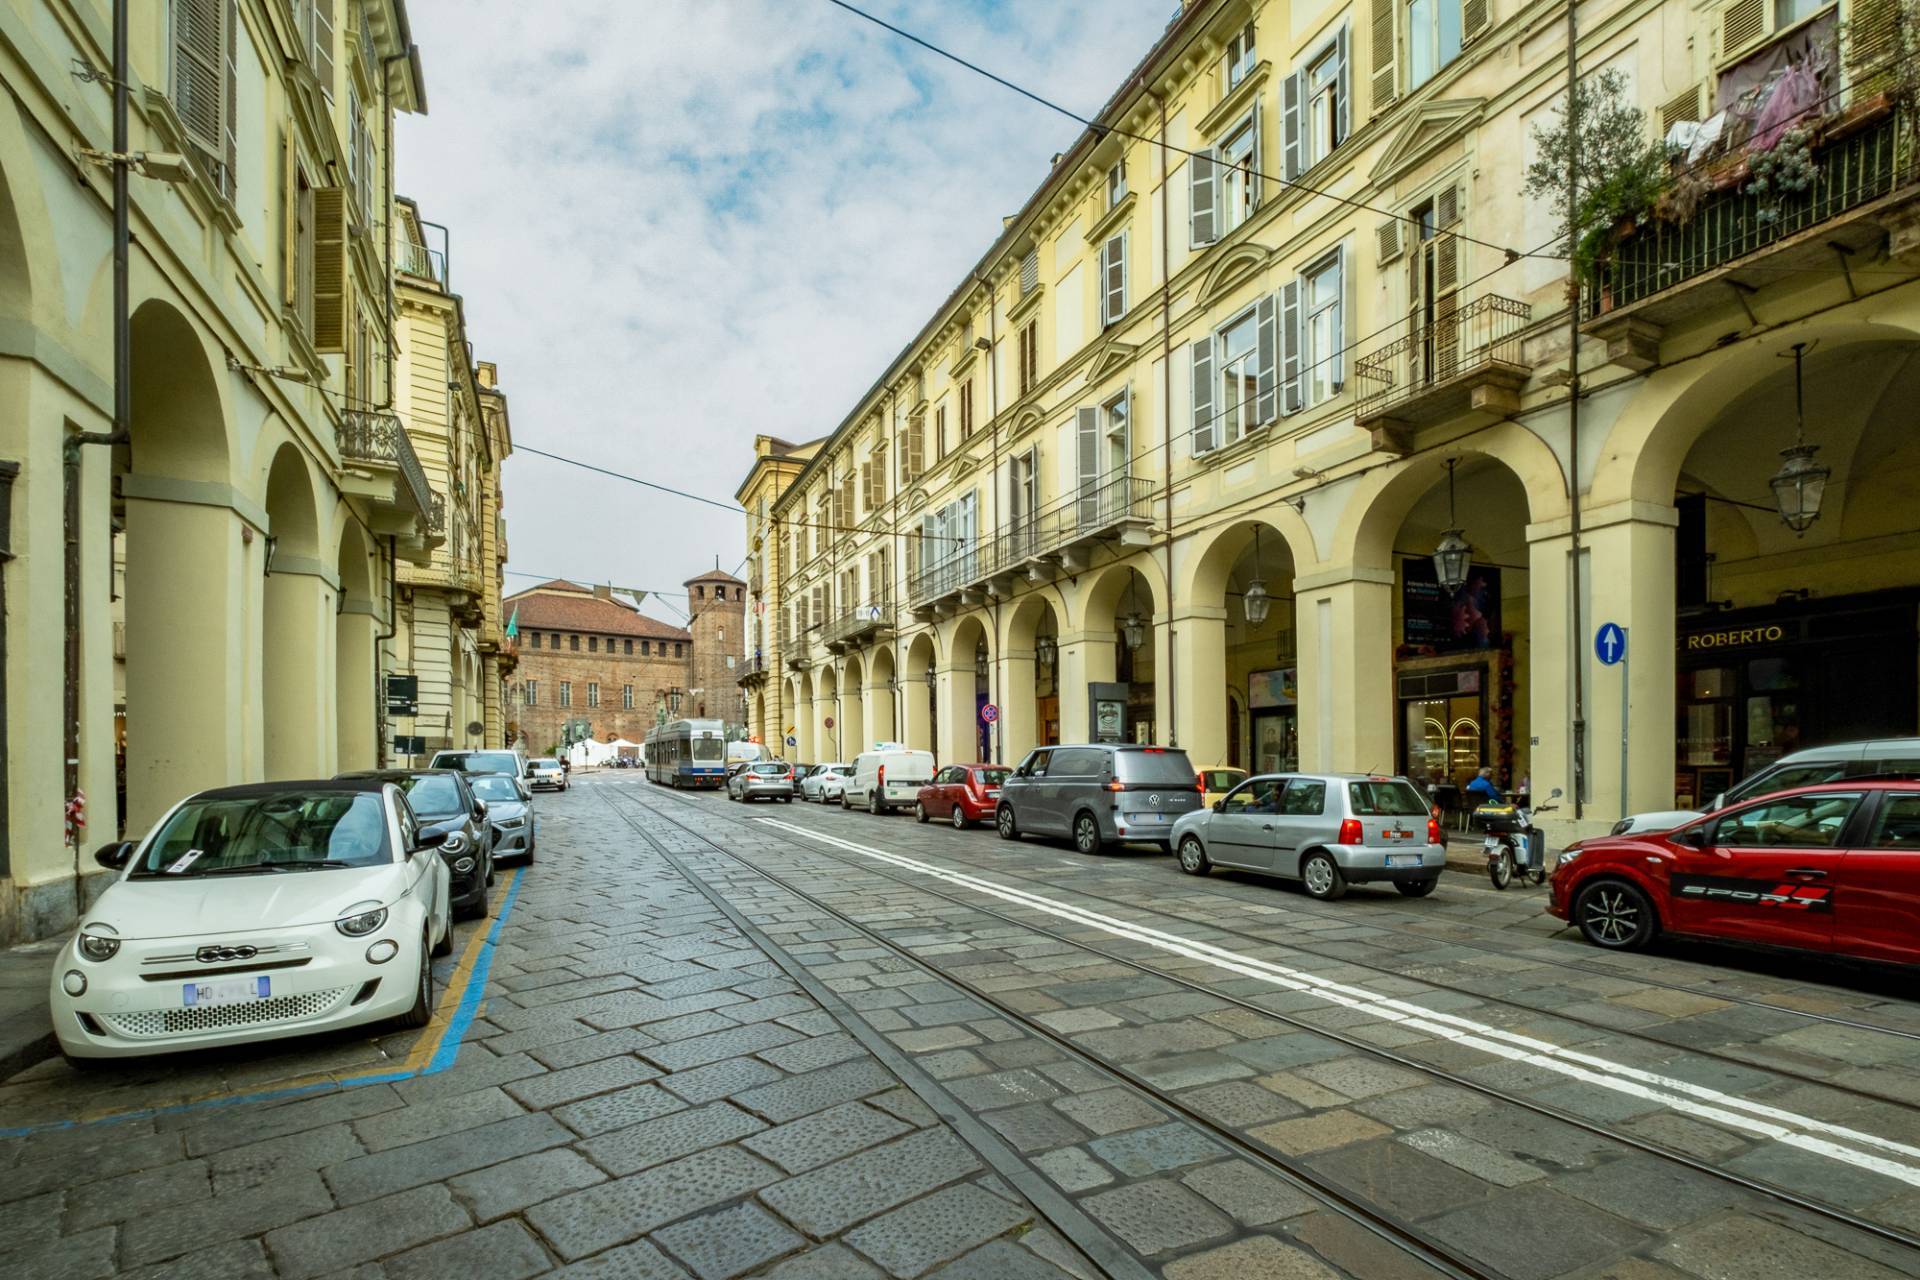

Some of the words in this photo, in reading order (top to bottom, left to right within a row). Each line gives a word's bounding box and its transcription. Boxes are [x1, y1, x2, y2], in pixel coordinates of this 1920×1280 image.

[1687, 626, 1782, 649] ROBERTO
[1682, 885, 1826, 905] SPORT
[196, 945, 258, 963] 500
